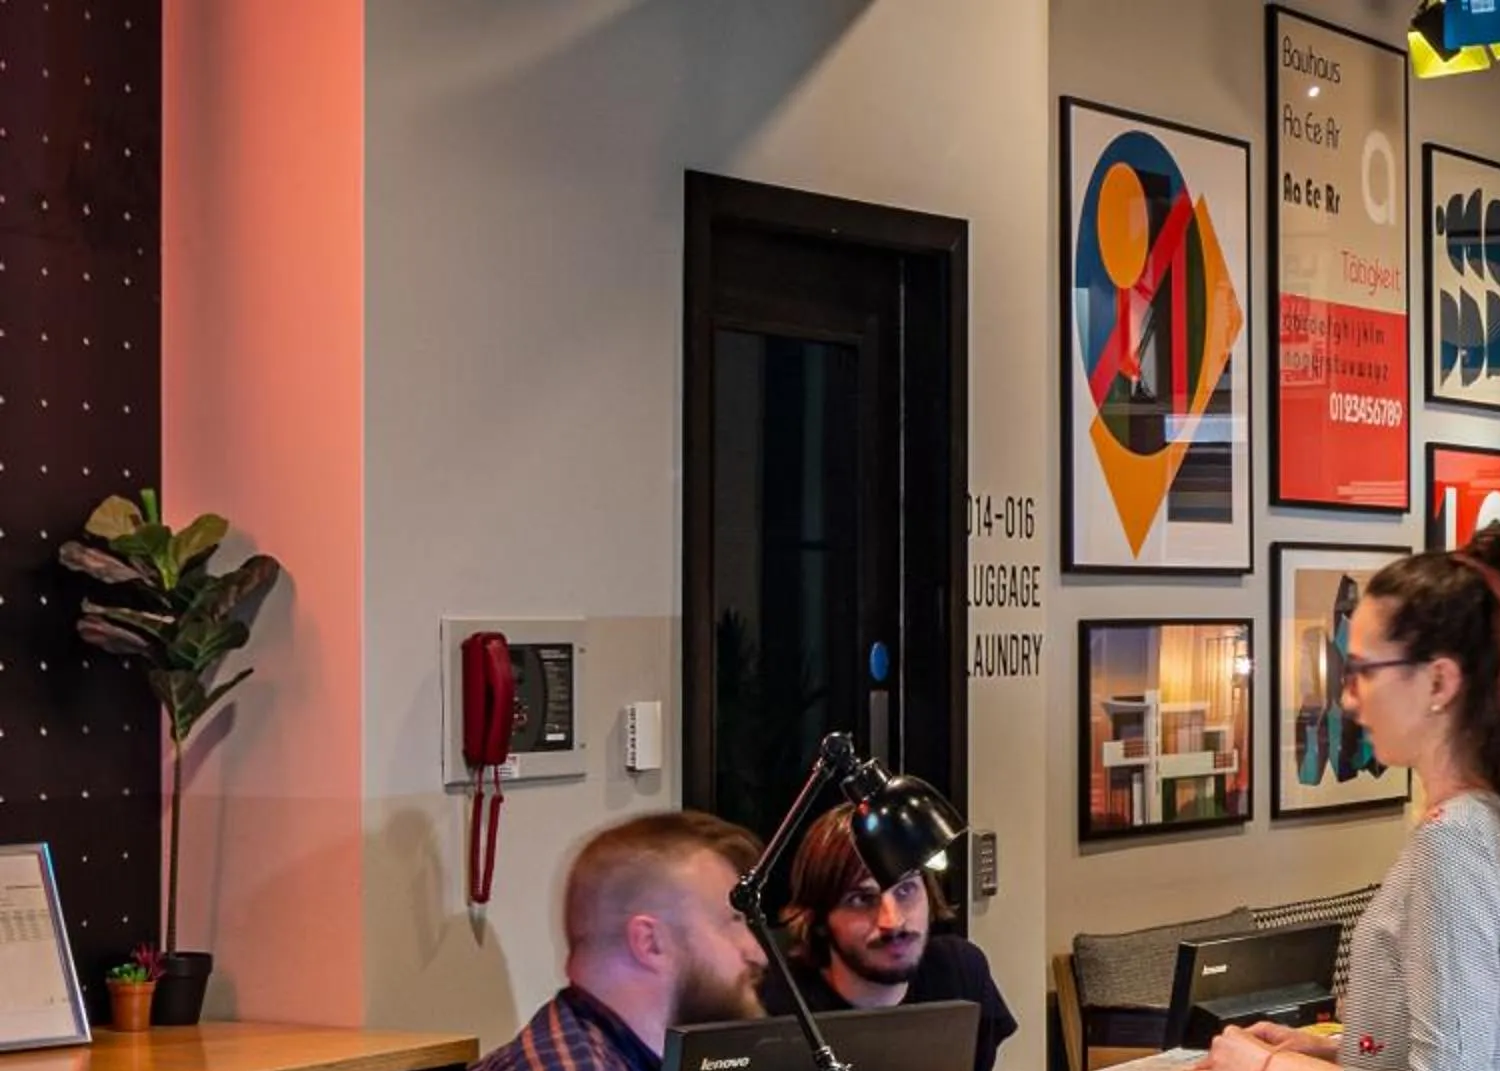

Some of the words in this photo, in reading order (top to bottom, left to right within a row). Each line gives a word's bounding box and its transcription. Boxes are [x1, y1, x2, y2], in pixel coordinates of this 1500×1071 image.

[1283, 35, 1341, 83] Bauhaus
[967, 565, 1041, 608] UGGAGE
[967, 633, 1043, 677] AUNDRY
